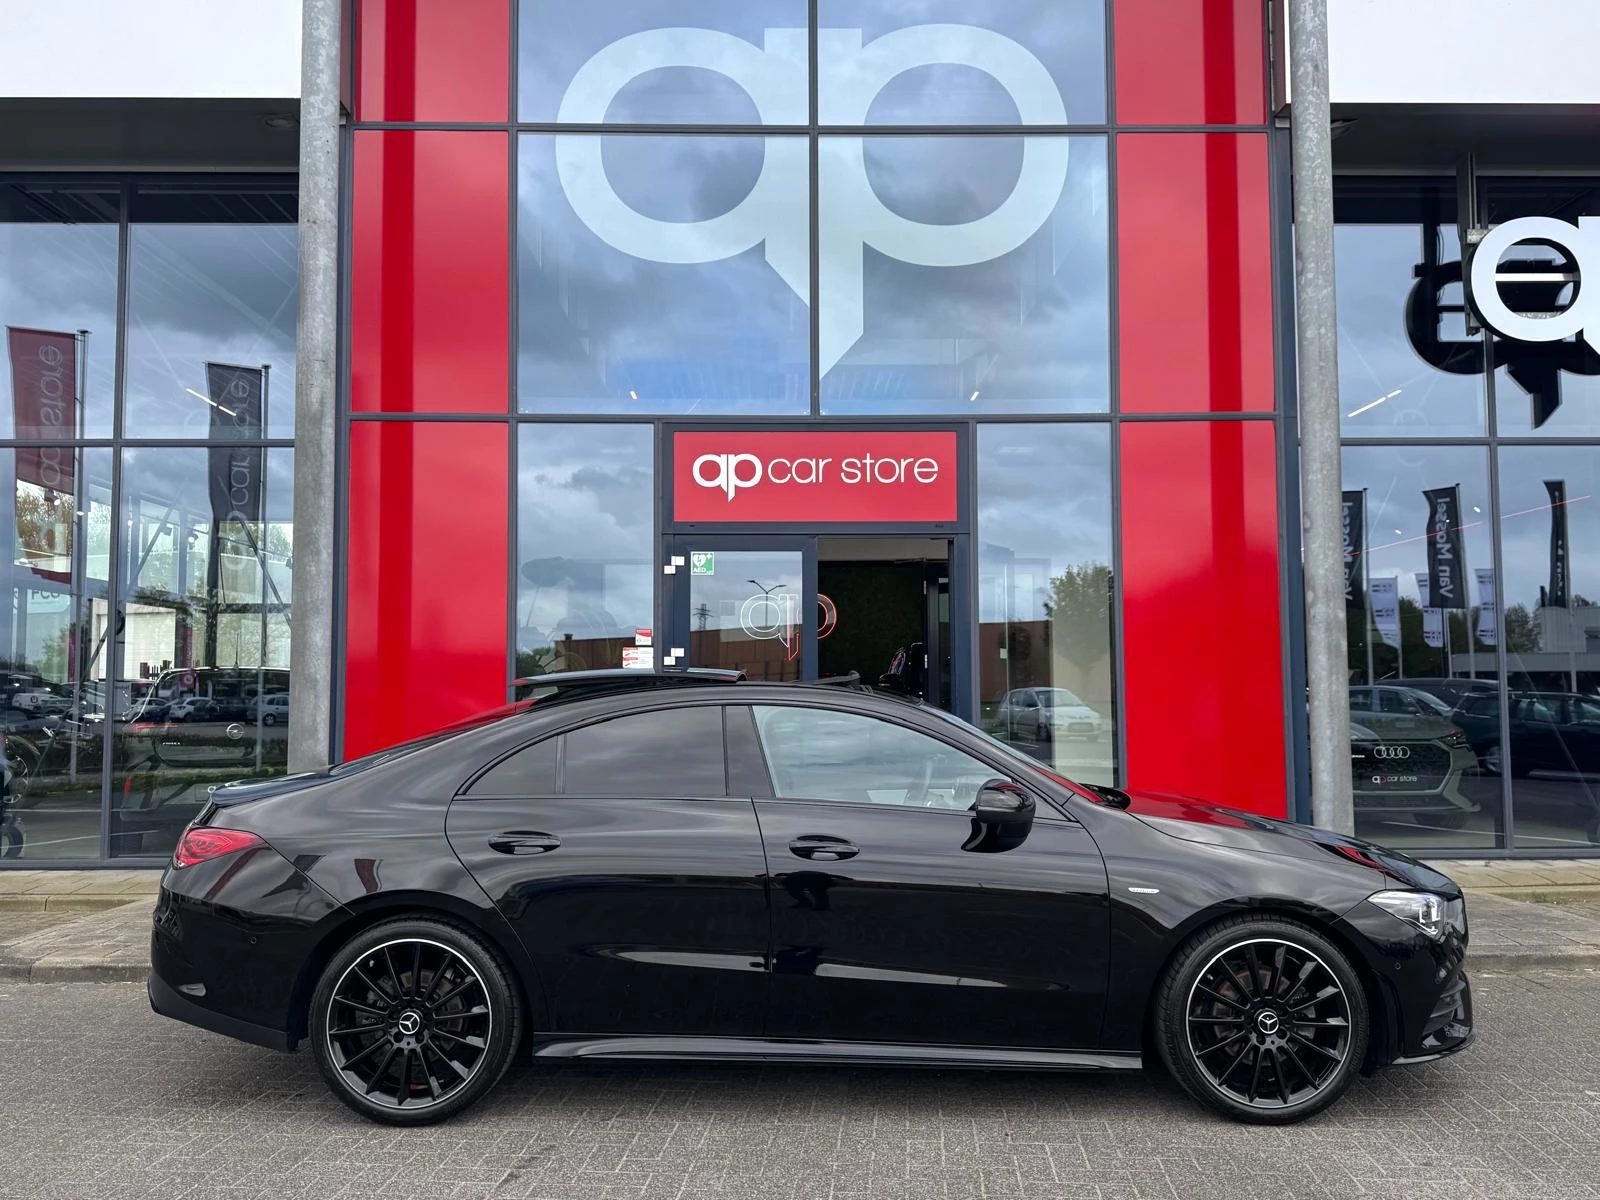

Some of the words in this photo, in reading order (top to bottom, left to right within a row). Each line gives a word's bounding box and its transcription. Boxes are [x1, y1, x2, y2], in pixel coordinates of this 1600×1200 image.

[556, 24, 1069, 380] ap
[692, 453, 763, 502] ap
[768, 457, 832, 483] car
[840, 452, 938, 483] store
